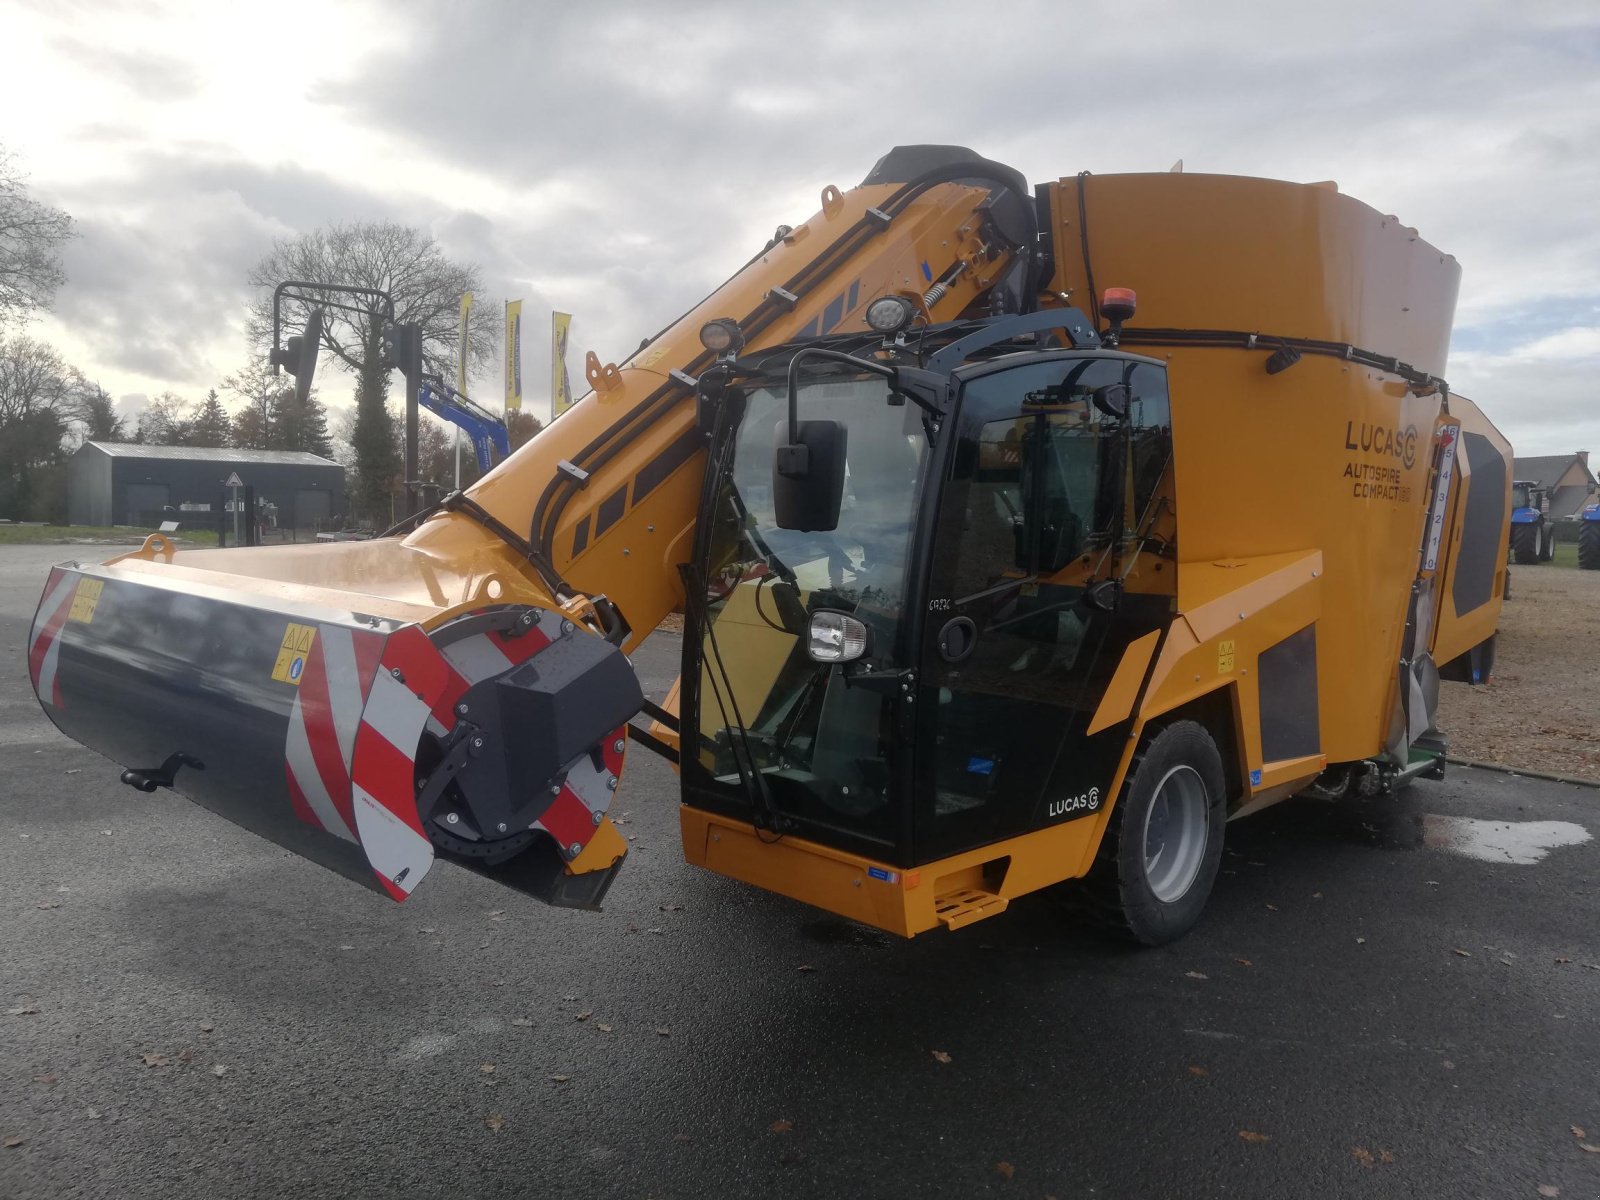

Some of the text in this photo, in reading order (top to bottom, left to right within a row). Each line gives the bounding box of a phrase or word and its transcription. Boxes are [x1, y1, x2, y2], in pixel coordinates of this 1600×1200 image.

[1448, 427, 1455, 436] 6
[1345, 421, 1403, 458] LUCAS
[1446, 449, 1452, 458] 5
[1343, 463, 1401, 483] AUTOSPIRE
[1442, 471, 1448, 479] 4
[1353, 483, 1399, 500] COMPACT
[1439, 493, 1445, 501] 3
[1435, 515, 1441, 523] 2
[1432, 537, 1437, 545] 1
[1428, 559, 1433, 568] 0
[1049, 794, 1087, 817] LUCAS
